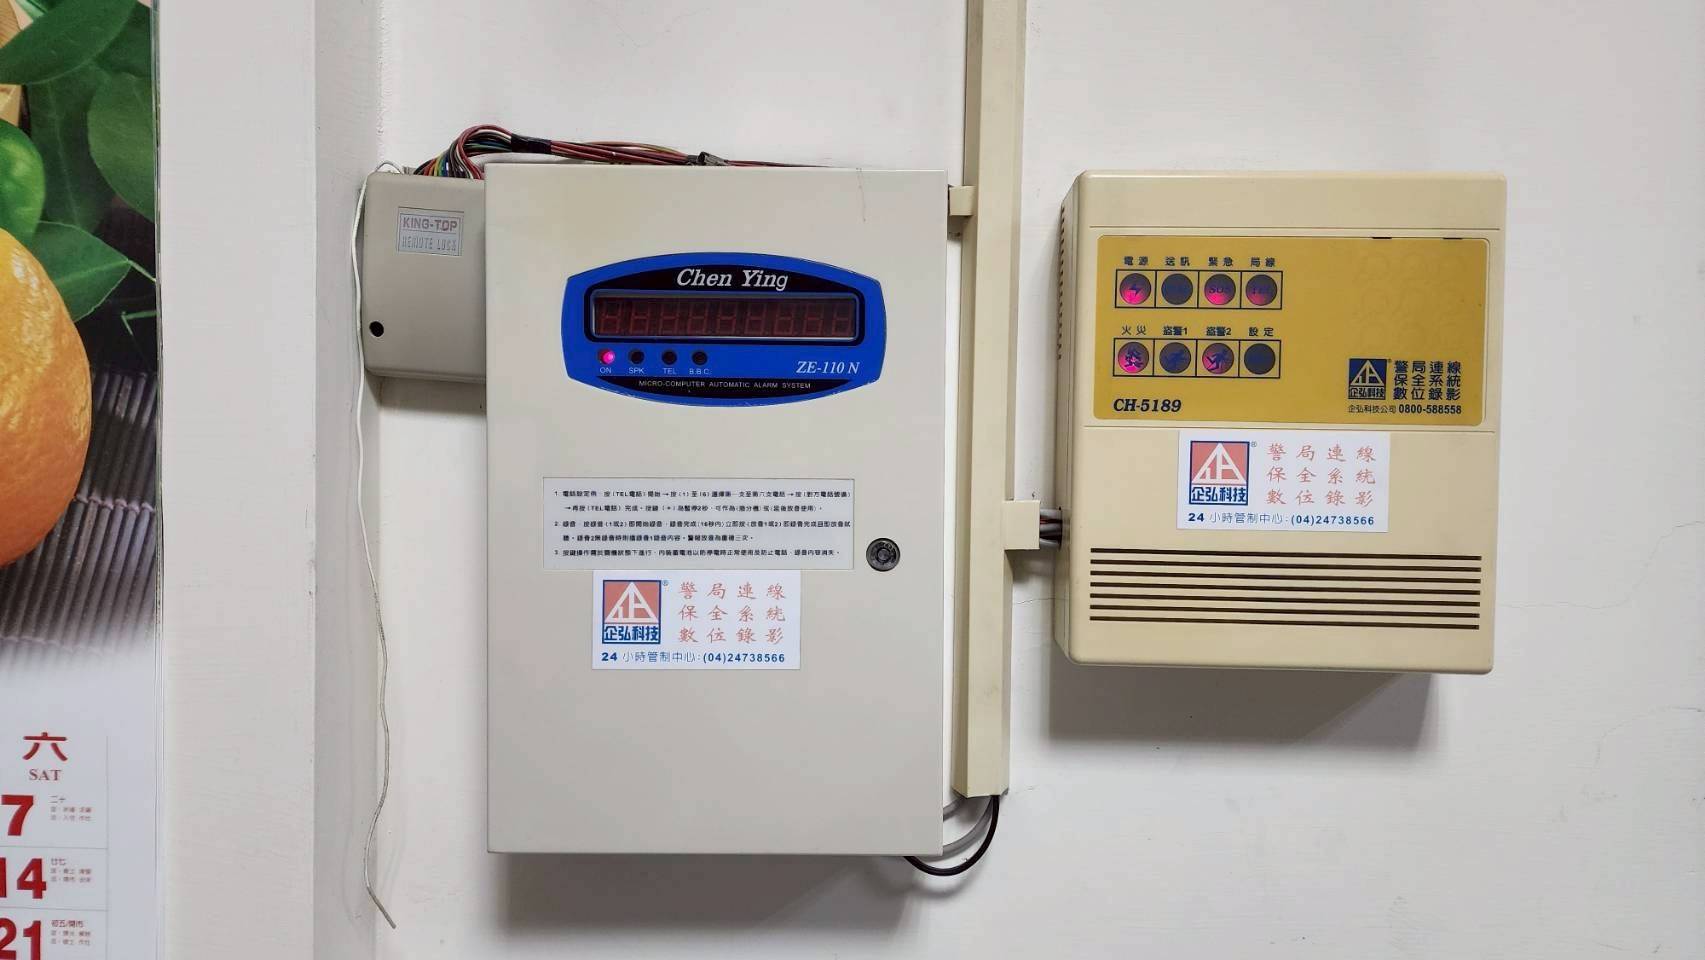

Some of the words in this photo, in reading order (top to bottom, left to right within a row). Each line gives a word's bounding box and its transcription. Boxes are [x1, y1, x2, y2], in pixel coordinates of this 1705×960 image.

[1124, 256, 1149, 266] 電源
[1208, 257, 1234, 267] 緊急
[677, 268, 732, 287] Chen
[740, 269, 789, 292] Ying
[1248, 327, 1274, 337] 設定
[599, 366, 612, 374] ON
[628, 366, 645, 374] SPK
[662, 367, 677, 375] TEL
[795, 361, 845, 374] ZE-110
[847, 361, 861, 374] N
[1393, 360, 1461, 374] 警局連線
[638, 380, 705, 388] MICRO-COMPUTER
[753, 381, 778, 389] ALARM
[1393, 375, 1461, 387] 保全系統
[1393, 388, 1461, 401] 數位錄影
[1113, 398, 1182, 412] CH-5189
[1398, 405, 1462, 414] 0800-588558
[1267, 442, 1377, 463] 警局連線
[1267, 466, 1377, 485] 保全系統
[1191, 486, 1247, 503] 企弘科技
[1266, 489, 1375, 508] 數位錄影
[1188, 512, 1205, 522] 24
[678, 581, 787, 601] 警局連線
[678, 604, 787, 623] 保全系統
[603, 625, 660, 641] 企弘科技
[677, 626, 786, 645] 數位錄影
[601, 651, 618, 662] 24
[22, 732, 68, 761] 六
[28, 768, 62, 782] SAT
[1, 794, 35, 836] 7
